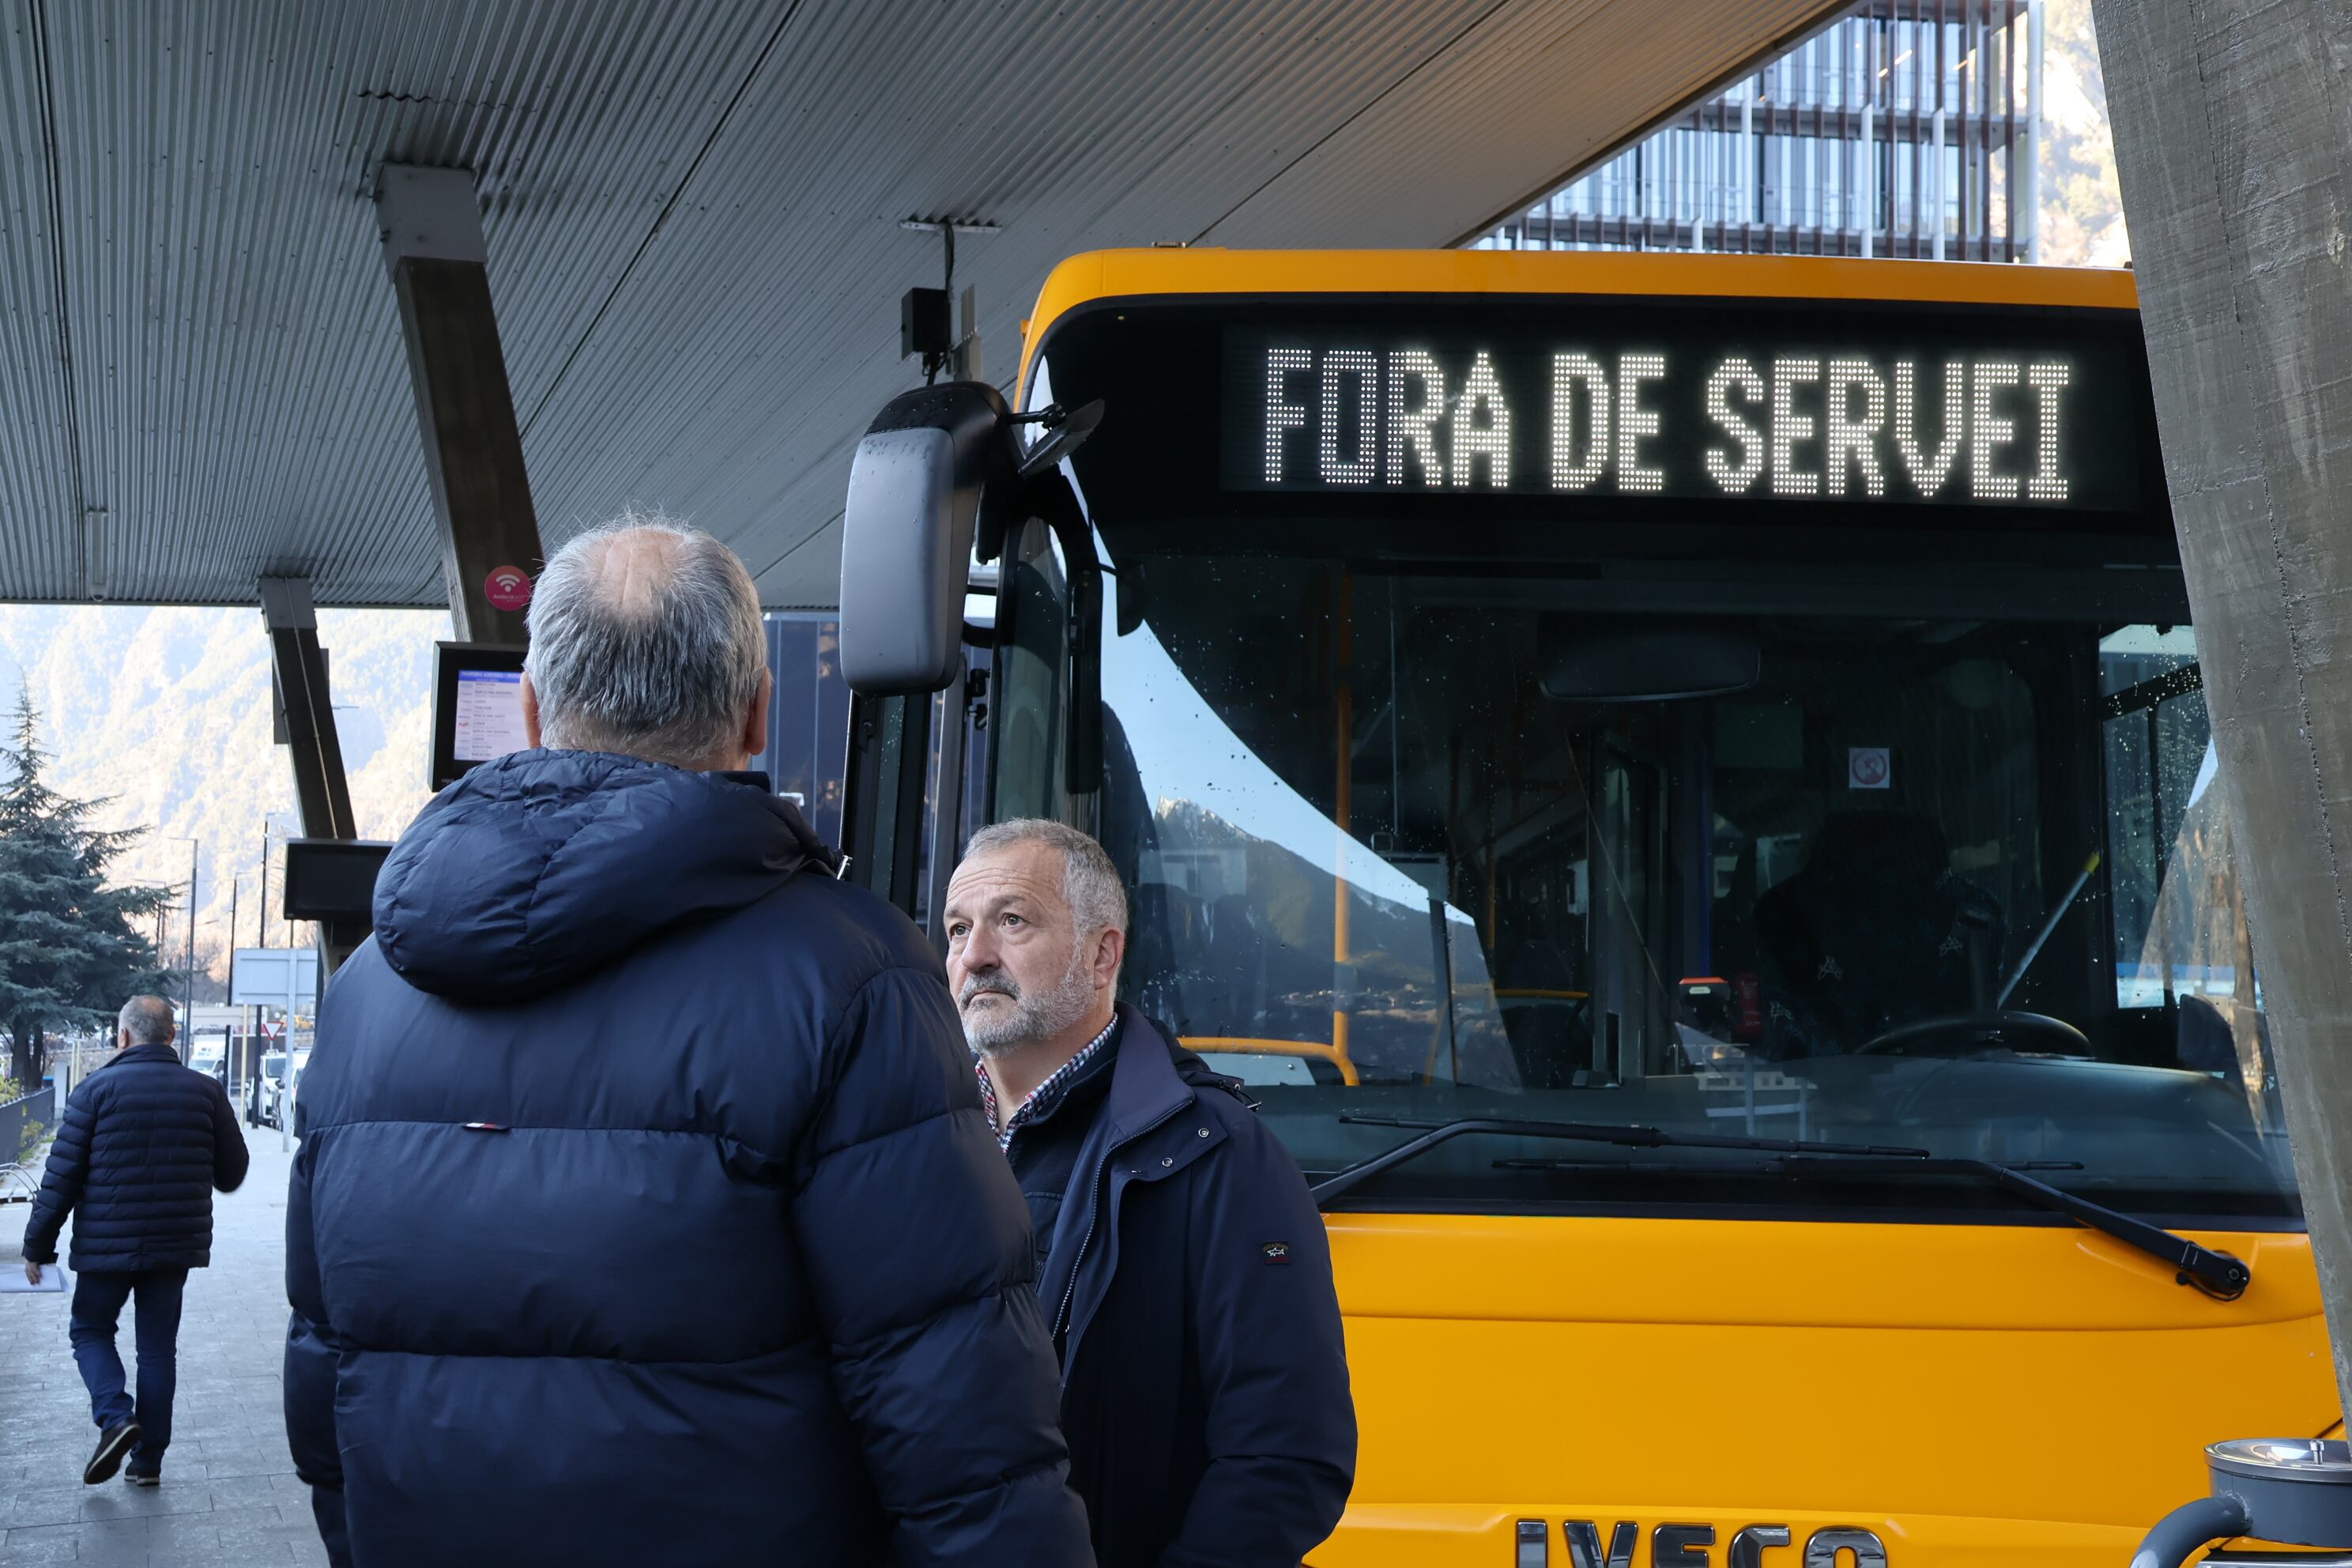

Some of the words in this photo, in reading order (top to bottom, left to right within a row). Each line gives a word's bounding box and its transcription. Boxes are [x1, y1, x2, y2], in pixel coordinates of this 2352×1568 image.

[1265, 348, 1512, 489] FORA
[1549, 352, 1666, 493] DE
[1705, 358, 2070, 501] SERVEI
